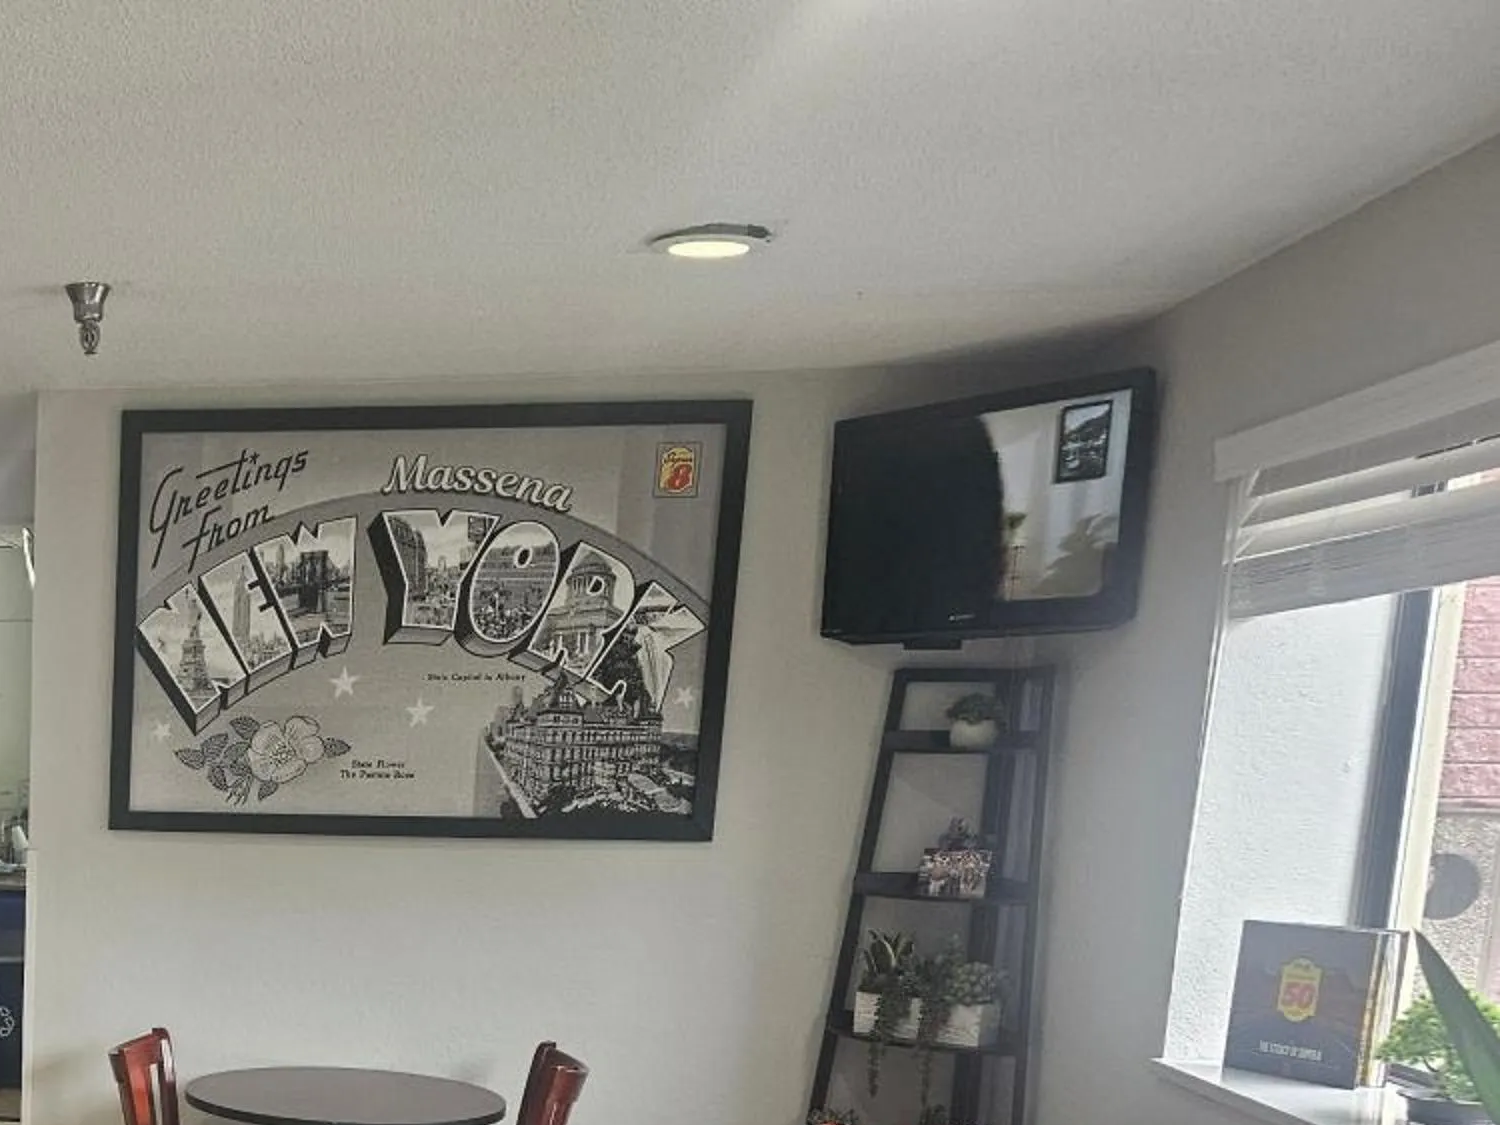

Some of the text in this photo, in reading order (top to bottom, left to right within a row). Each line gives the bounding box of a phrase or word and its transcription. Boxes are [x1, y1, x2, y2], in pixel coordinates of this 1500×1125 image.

[149, 448, 309, 569] Greetings
[380, 453, 576, 513] Massena
[182, 504, 276, 574] From
[136, 507, 708, 735] NEW YORK
